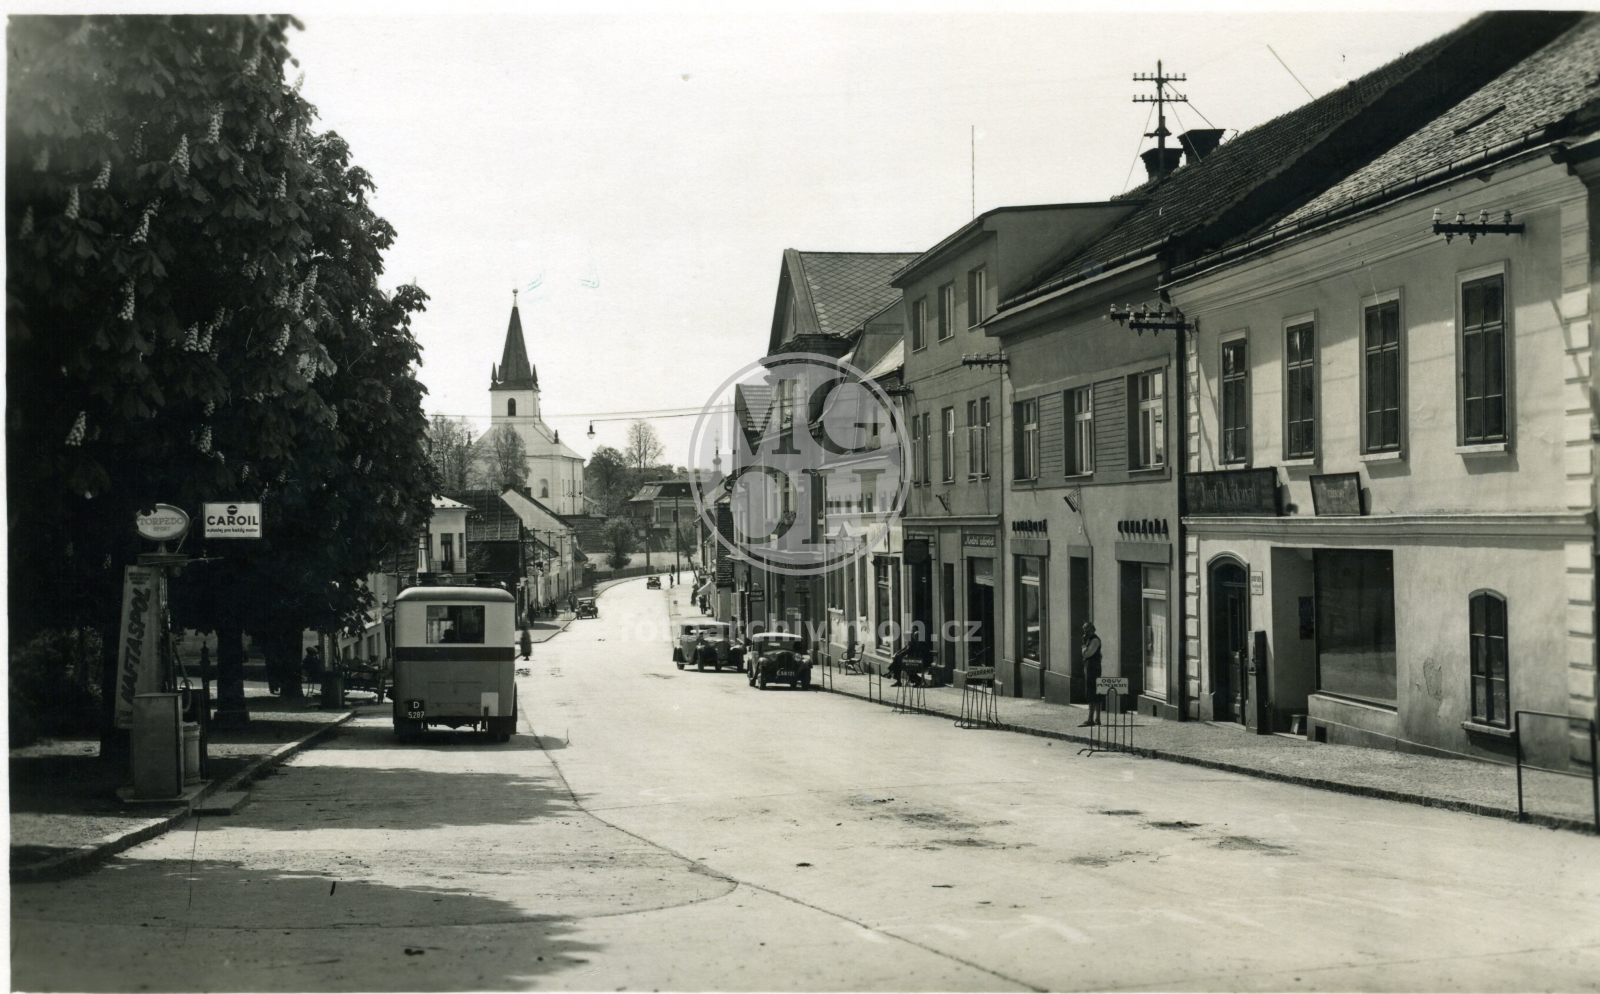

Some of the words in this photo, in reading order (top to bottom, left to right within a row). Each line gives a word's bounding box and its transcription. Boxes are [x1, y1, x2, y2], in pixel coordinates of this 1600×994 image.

[139, 517, 185, 525] TORPEDO
[207, 515, 259, 526] CAROIL
[120, 587, 151, 706] NAFTASPOL
[413, 701, 420, 709] D
[408, 711, 425, 719] 5287
